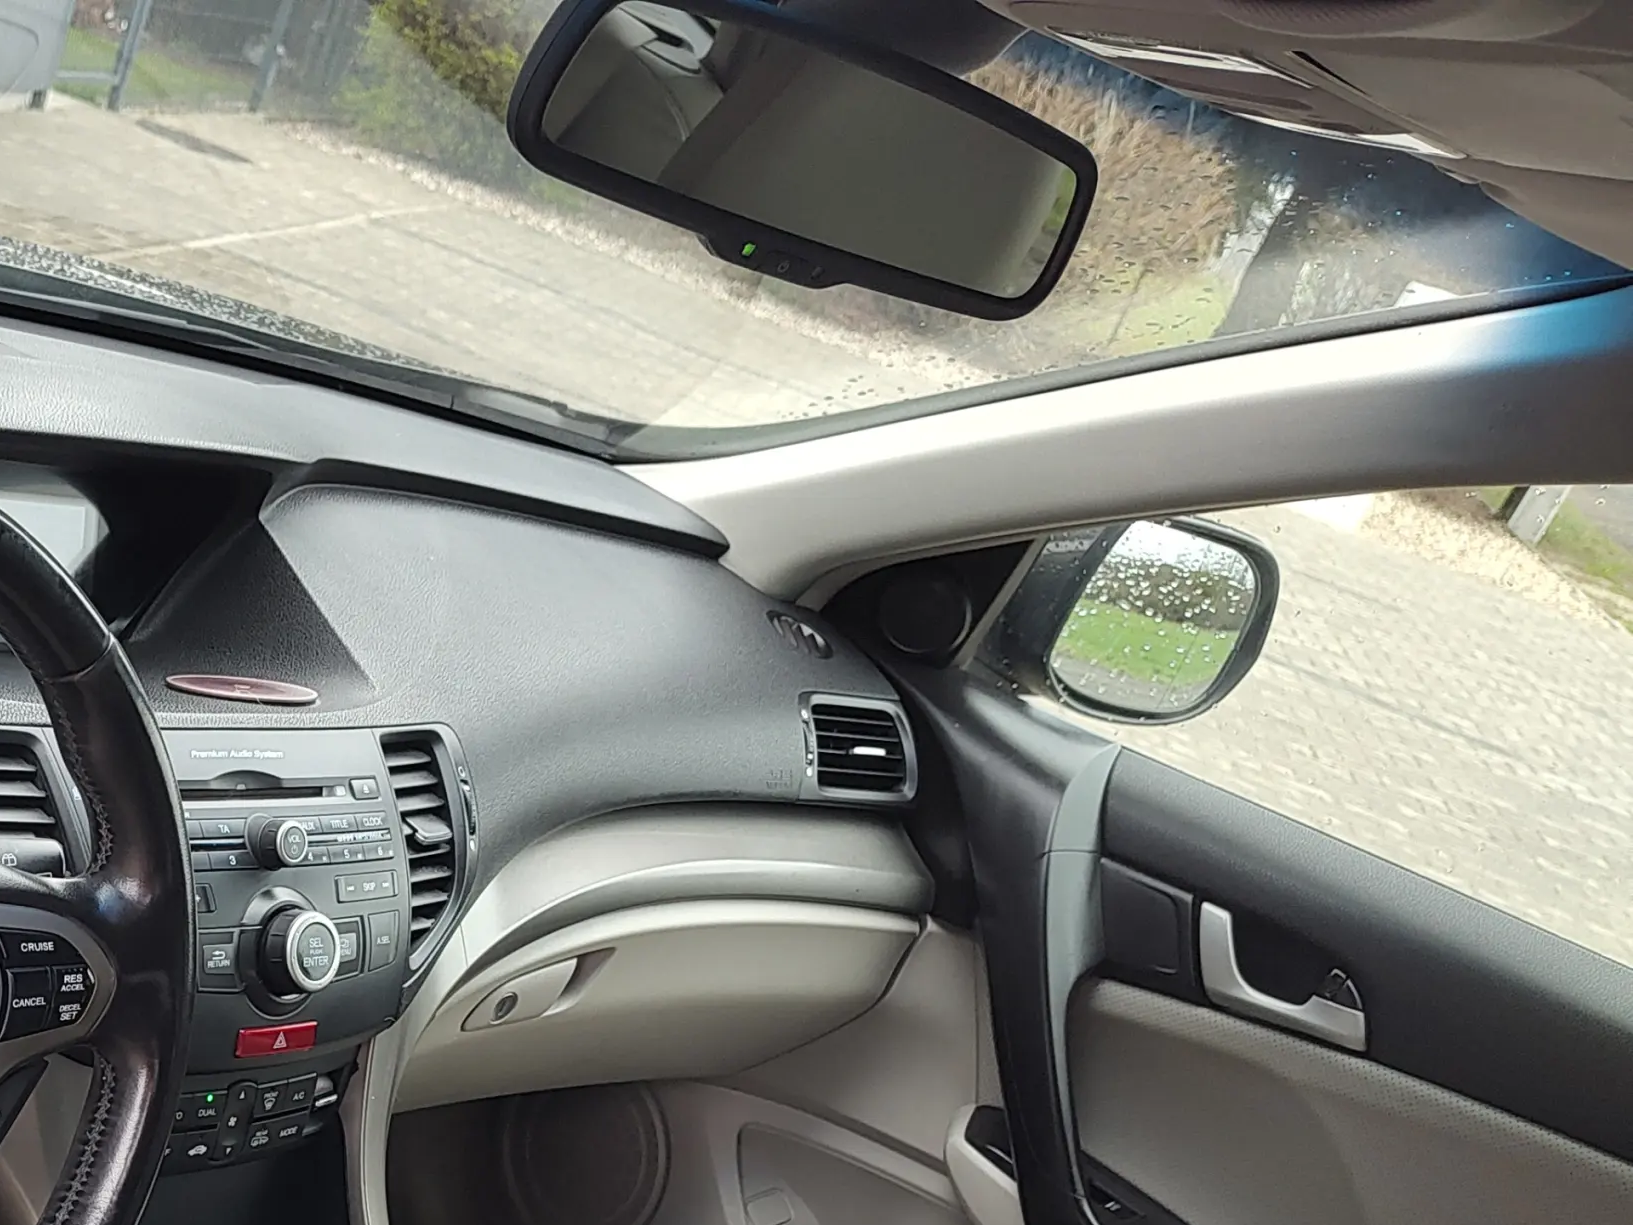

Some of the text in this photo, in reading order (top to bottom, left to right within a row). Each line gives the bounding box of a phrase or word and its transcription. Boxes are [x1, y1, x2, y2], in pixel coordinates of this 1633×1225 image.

[191, 750, 284, 759] Premium Audio System
[330, 820, 349, 829] TITLE
[362, 816, 383, 826] CLOCK
[218, 824, 230, 833] TA
[287, 834, 301, 844] VOL
[307, 851, 314, 861] 4
[343, 849, 350, 859] 5
[229, 856, 236, 865] 3
[21, 942, 54, 952] CRUISE
[309, 937, 323, 948] SEL
[207, 959, 230, 968] RETURN
[303, 956, 329, 967] ENTER
[64, 974, 83, 984] RES
[60, 984, 85, 992] ACCEL
[12, 997, 46, 1008] CANCEL
[59, 1004, 82, 1013] DECEL
[60, 1011, 78, 1021] SET
[198, 1109, 216, 1117] DUAL
[279, 1126, 298, 1137] MODE
